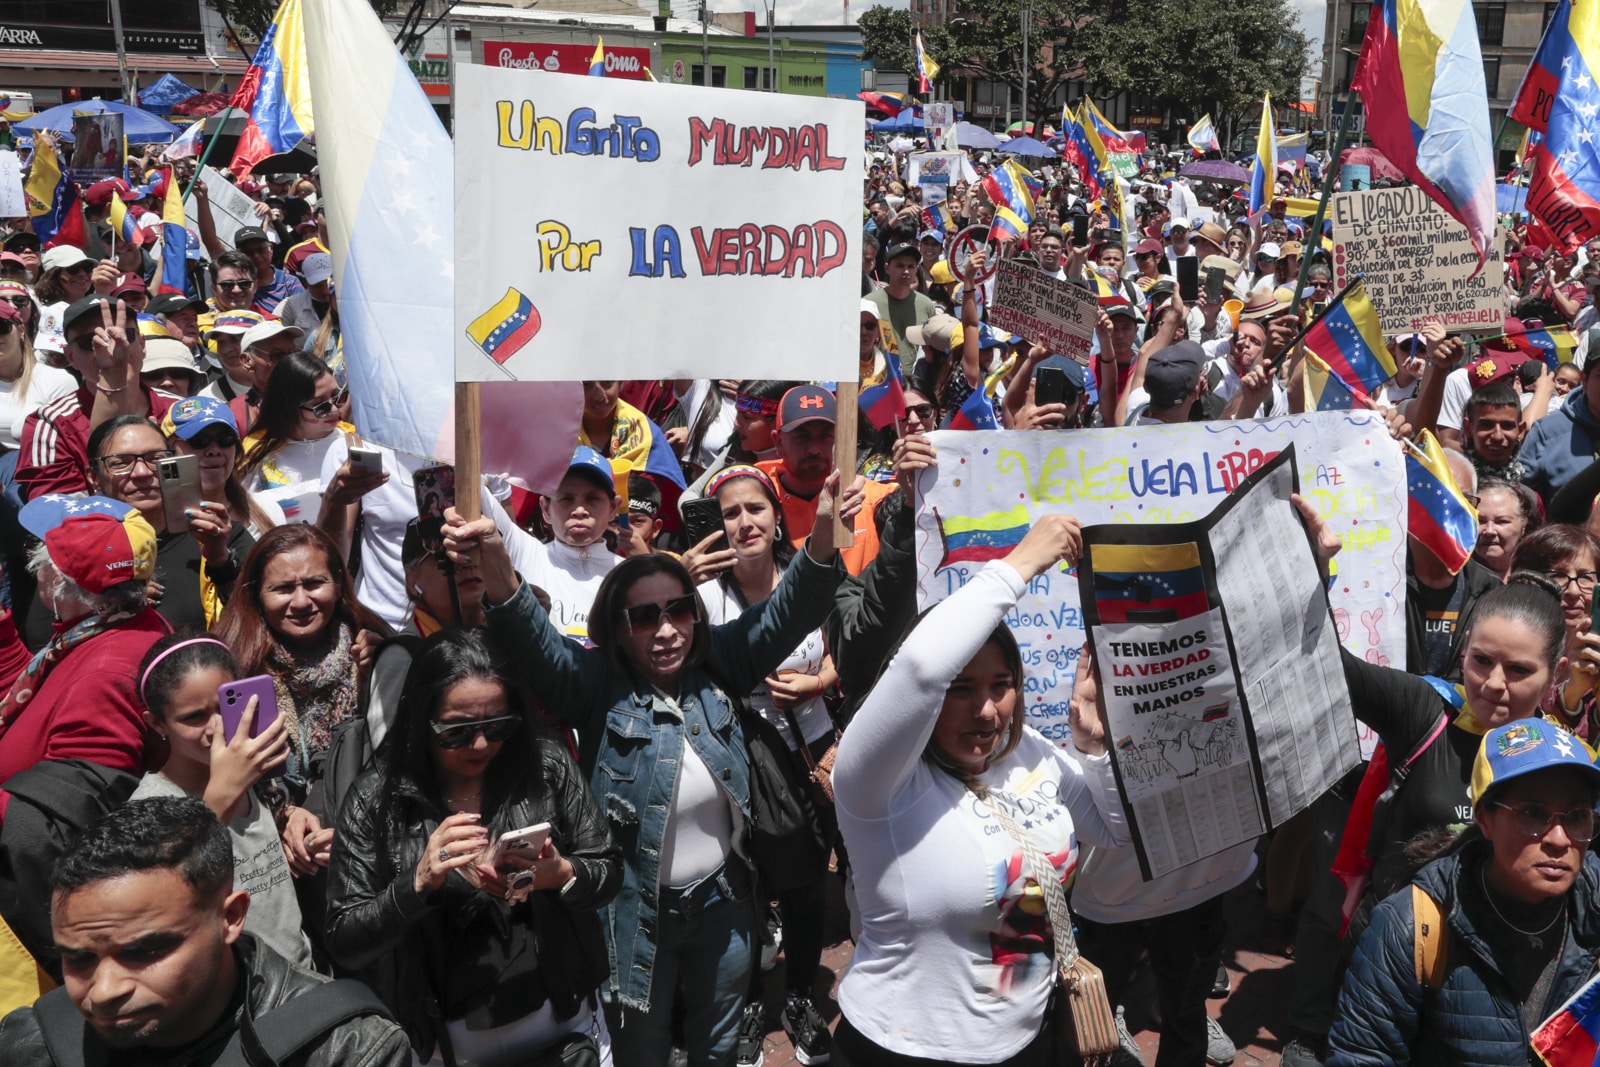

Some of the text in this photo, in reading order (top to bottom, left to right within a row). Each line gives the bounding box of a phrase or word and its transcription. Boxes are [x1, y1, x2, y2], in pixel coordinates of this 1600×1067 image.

[0, 27, 43, 45] ARRA
[122, 36, 199, 44] ESTAURANTE
[498, 48, 541, 69] Presto
[605, 52, 641, 72] Oma
[496, 100, 562, 155] Un
[688, 116, 846, 171] MUNDIAL
[1336, 195, 1359, 224] EL
[1535, 187, 1592, 247] LIBRE
[536, 219, 847, 278] Por LA VERDAD
[1381, 235, 1407, 249] $600
[1347, 250, 1369, 262] 90%
[1037, 272, 1054, 287] ERES
[1057, 280, 1070, 293] ESE
[1425, 621, 1450, 633] LUE
[1109, 630, 1207, 657] TENEMOS
[1113, 648, 1211, 677] LA VERDAD
[1114, 664, 1217, 696] EN NUESTRAS
[1133, 686, 1206, 715] MANOS
[240, 866, 265, 882] Pretty
